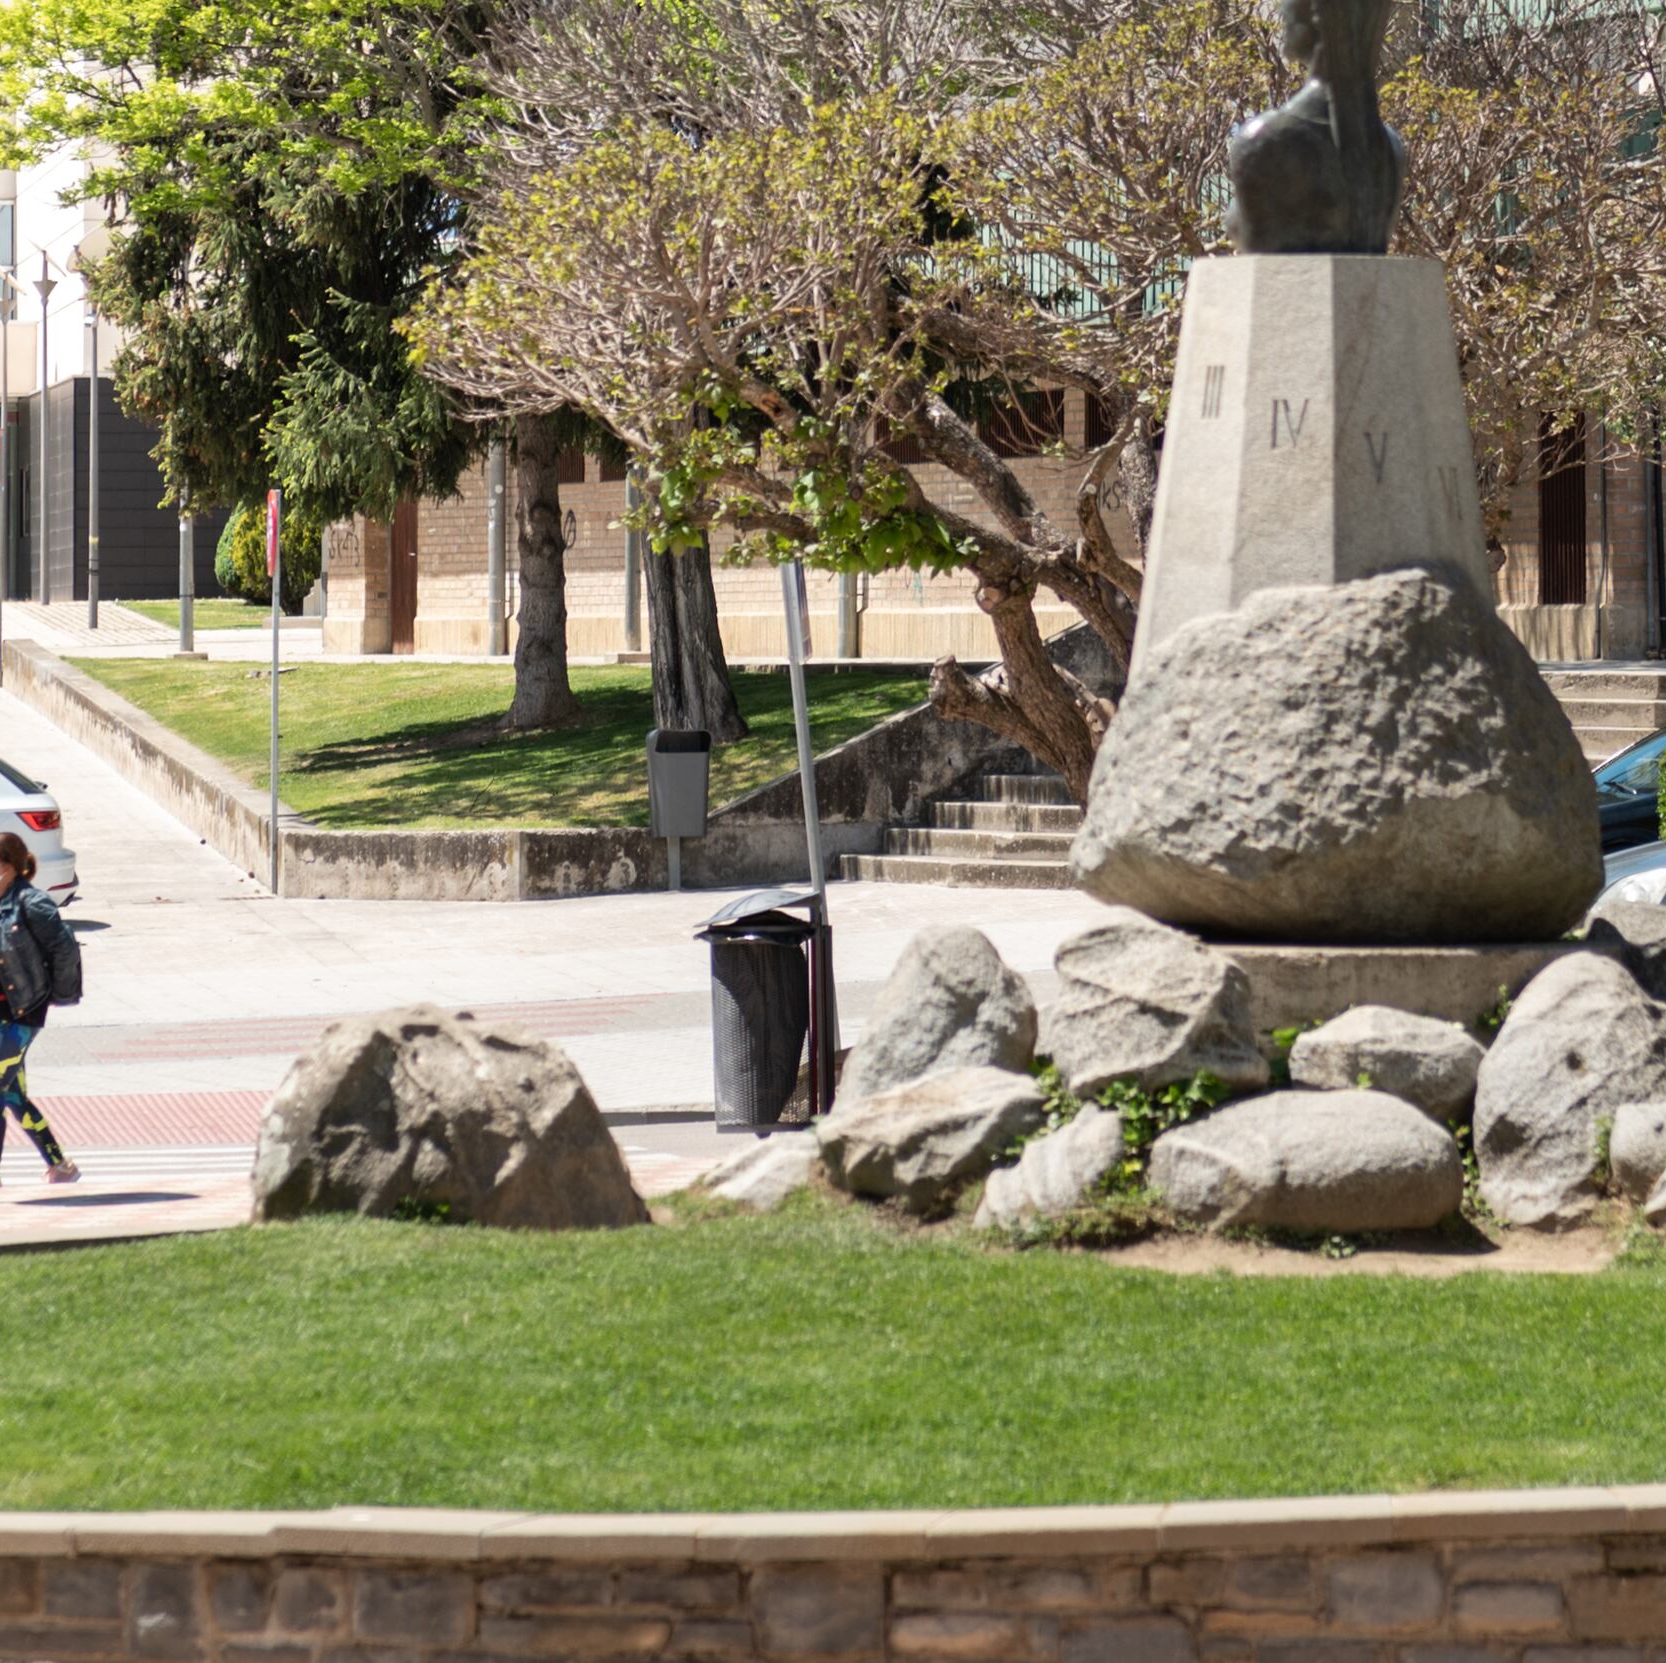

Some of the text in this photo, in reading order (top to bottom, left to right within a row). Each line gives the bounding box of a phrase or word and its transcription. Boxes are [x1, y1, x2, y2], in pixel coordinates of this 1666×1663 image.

[1201, 365, 1225, 419] III
[1270, 398, 1310, 449] IV
[1362, 431, 1389, 484] V
